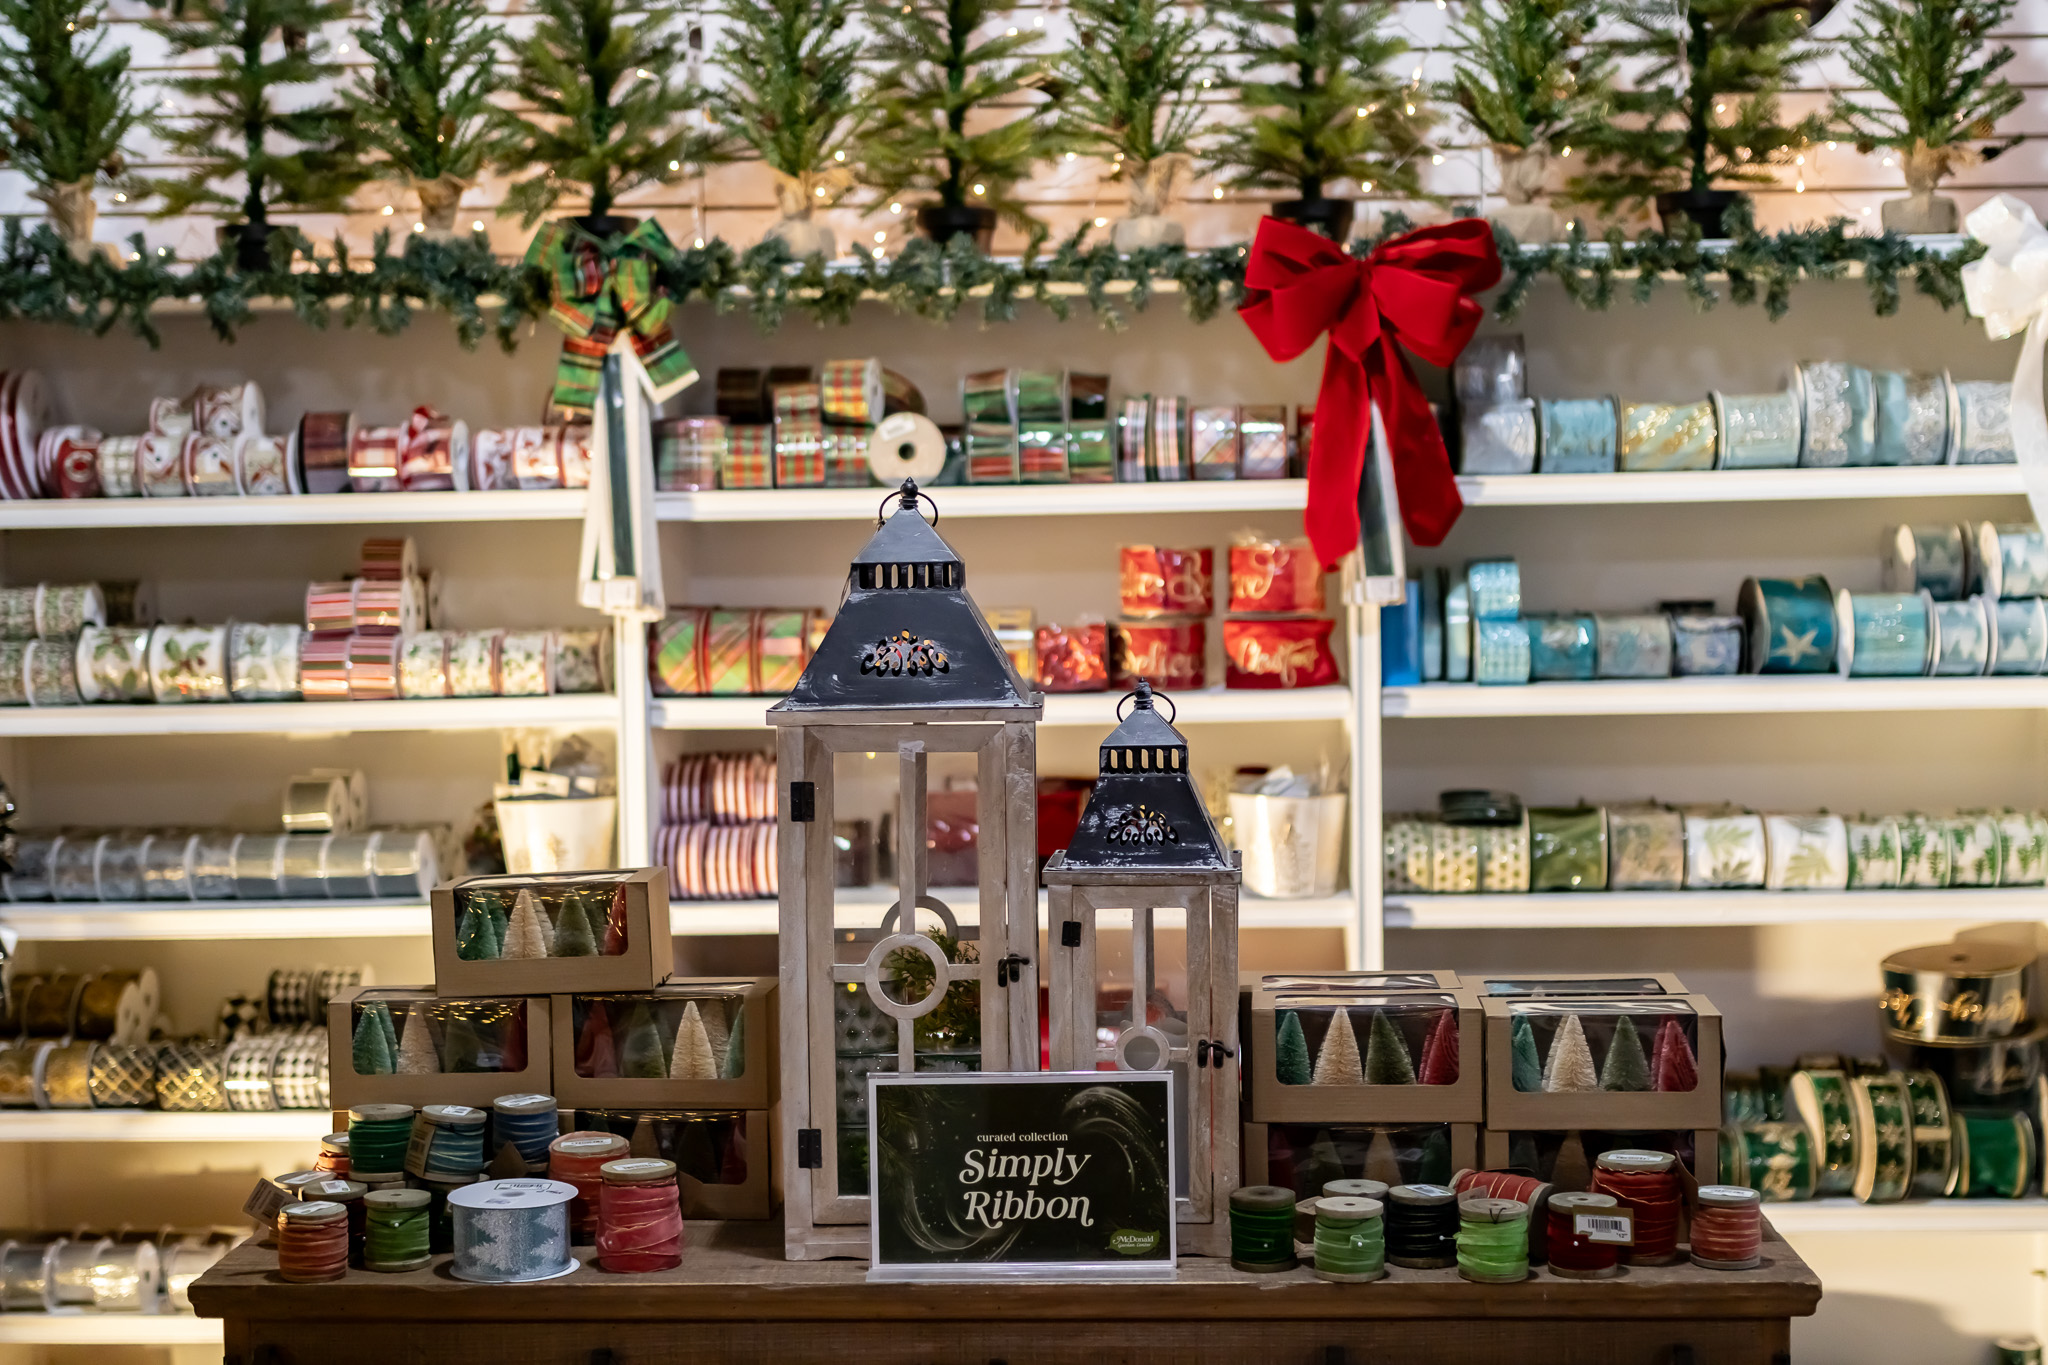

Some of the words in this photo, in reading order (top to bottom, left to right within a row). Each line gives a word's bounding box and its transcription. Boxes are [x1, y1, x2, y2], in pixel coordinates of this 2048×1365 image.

[977, 1132, 1016, 1142] curated
[1019, 1132, 1069, 1142] collection
[959, 1147, 1092, 1186] Simply
[963, 1190, 1094, 1229] Ribbon
[1112, 1235, 1154, 1244] McDonald
